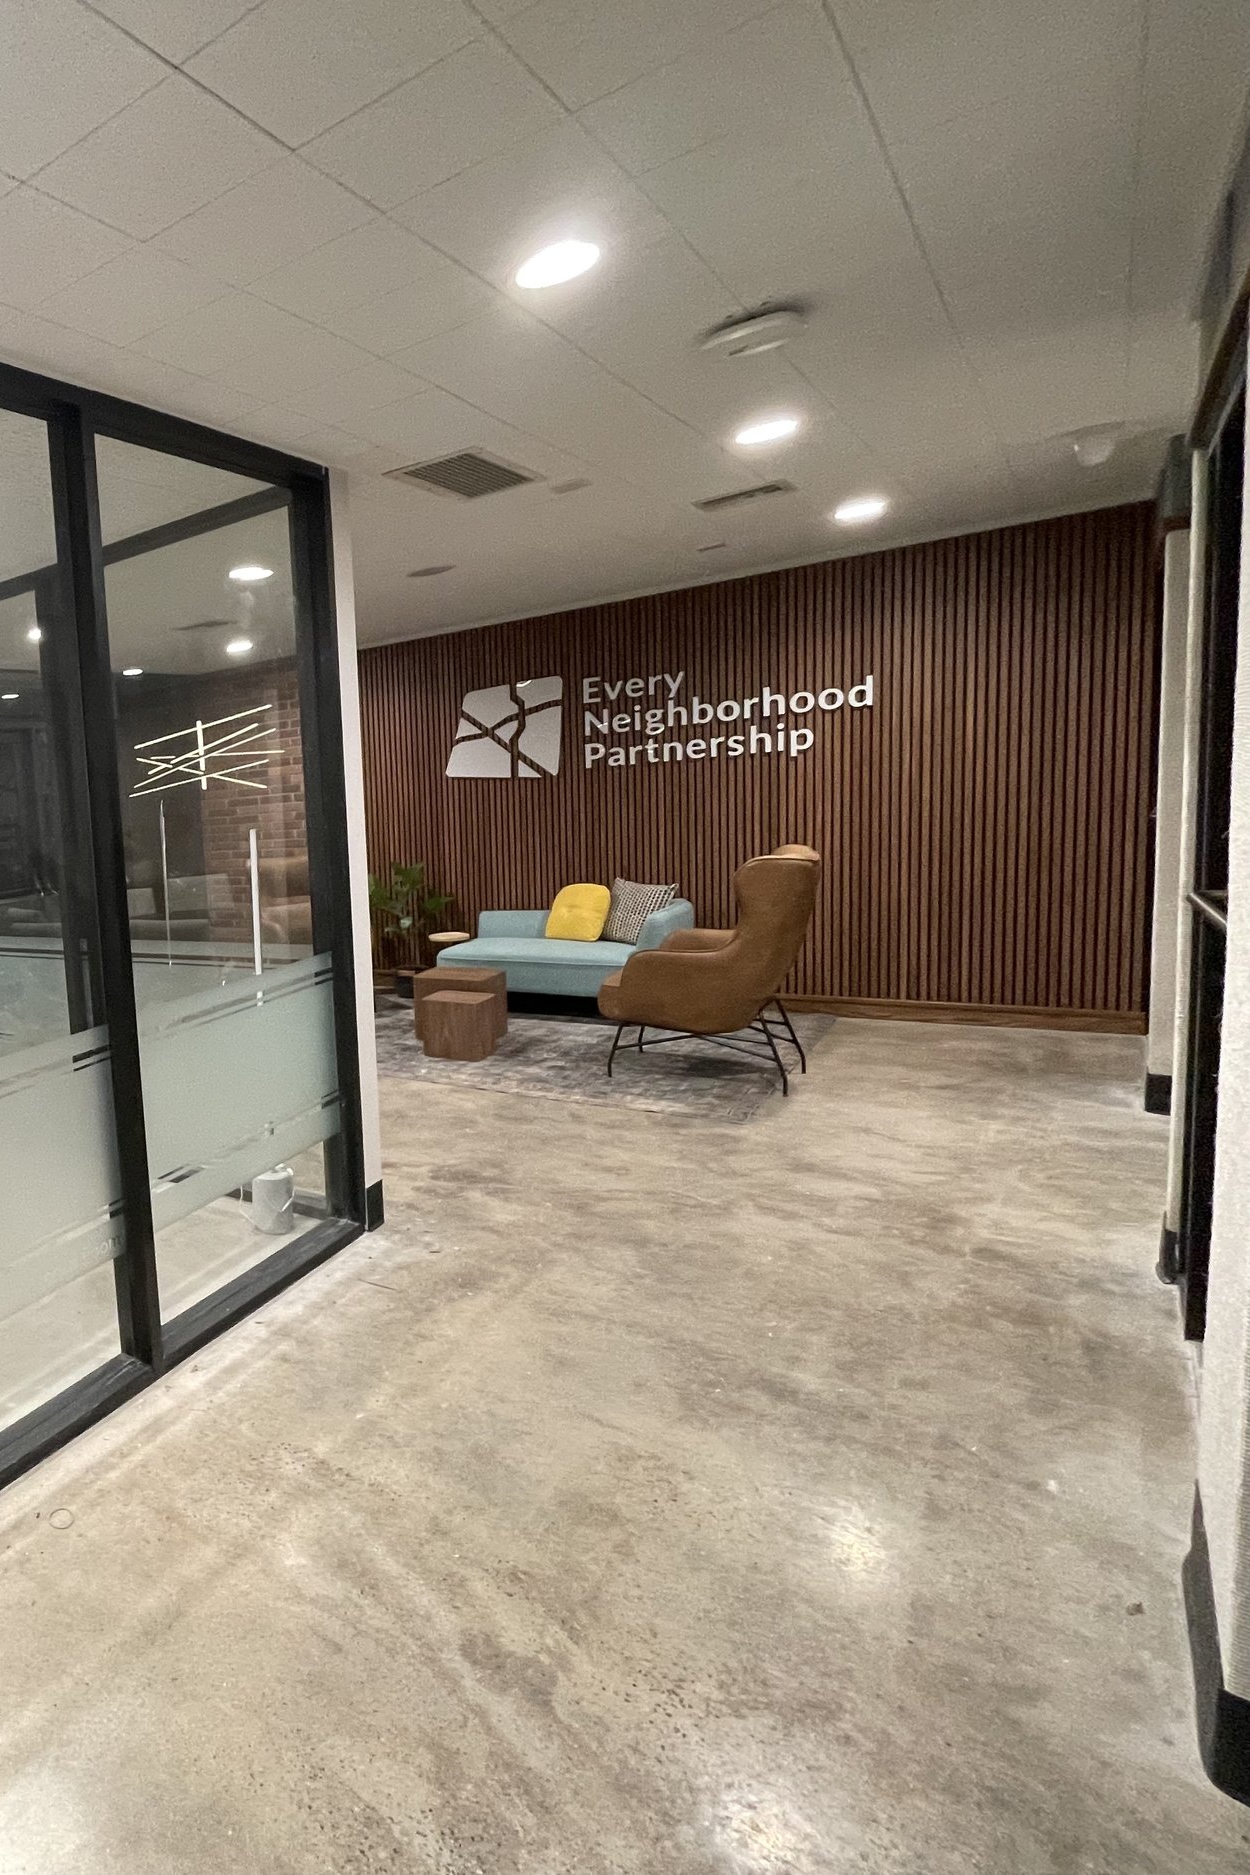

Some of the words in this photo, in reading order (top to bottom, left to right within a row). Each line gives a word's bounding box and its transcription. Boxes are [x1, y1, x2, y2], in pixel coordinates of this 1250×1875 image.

[582, 671, 684, 703] Every
[583, 674, 874, 736] Neighborhood
[584, 724, 814, 768] Partnership
